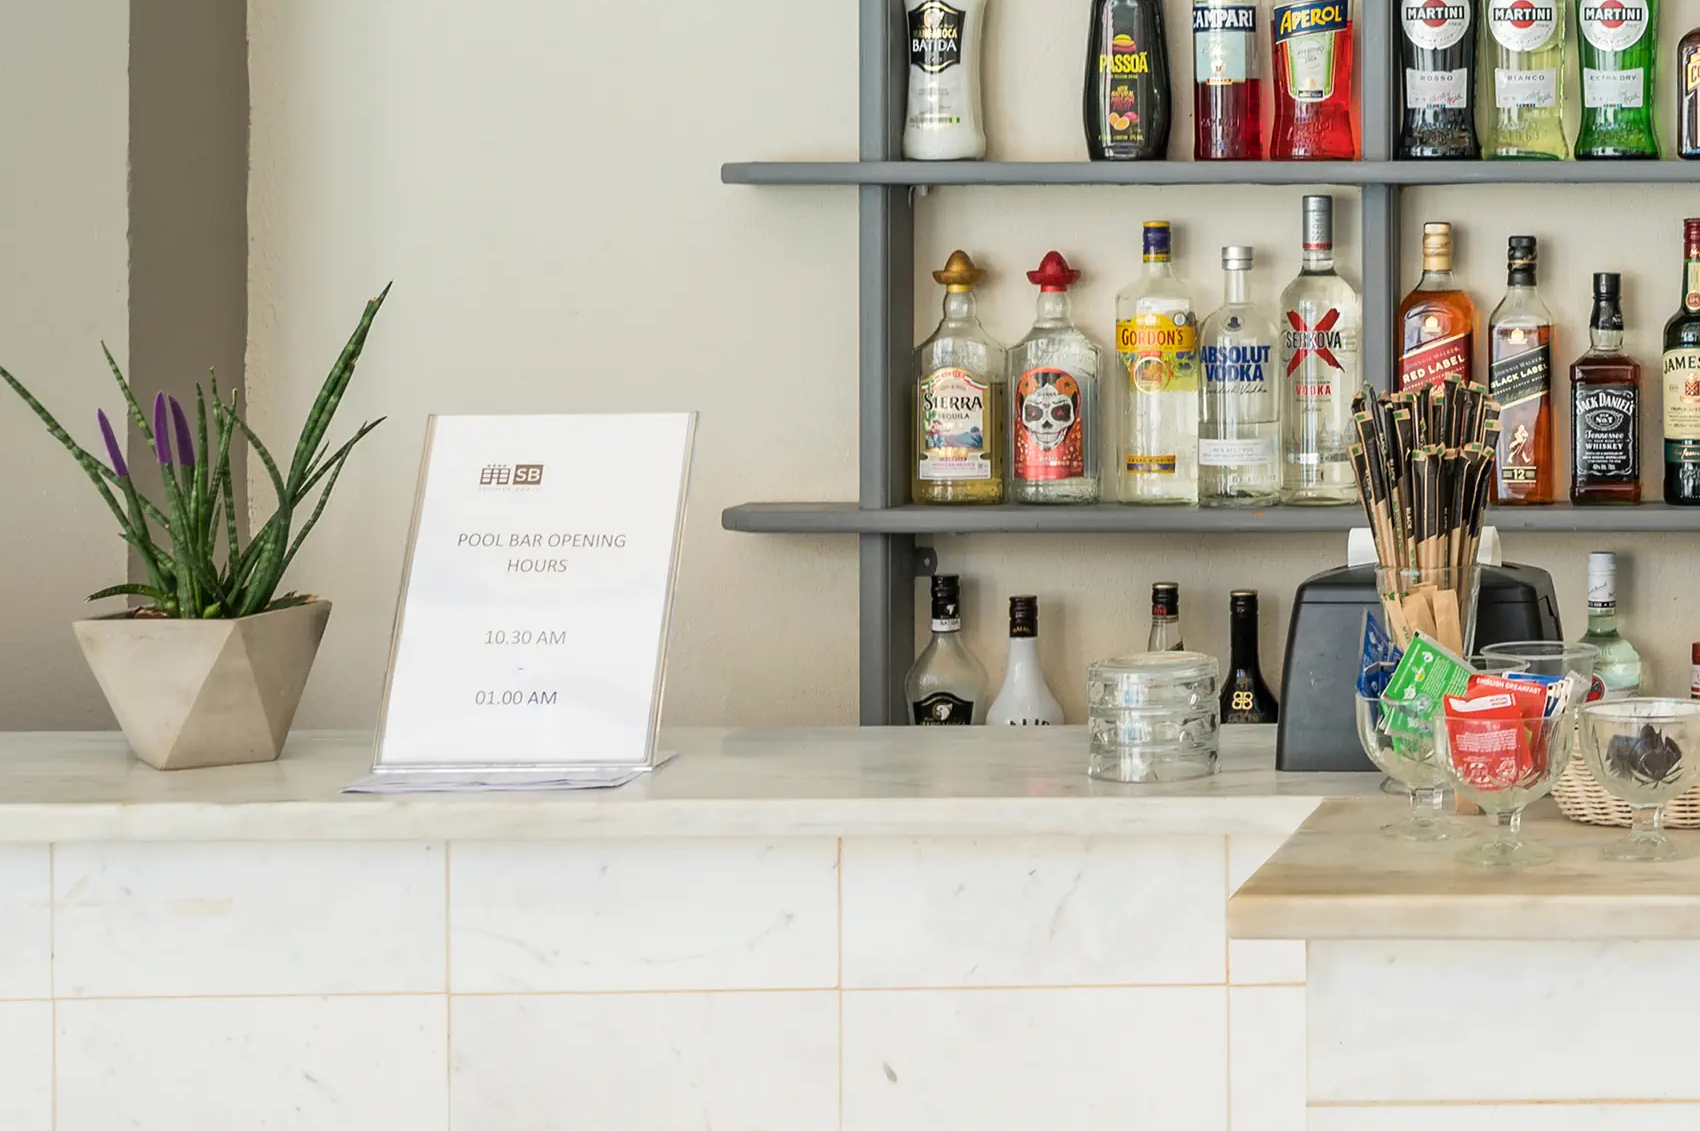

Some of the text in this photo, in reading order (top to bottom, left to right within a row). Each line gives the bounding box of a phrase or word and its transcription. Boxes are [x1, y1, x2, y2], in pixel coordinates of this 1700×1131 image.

[1280, 5, 1343, 35] APEROL
[1406, 6, 1464, 20] MARTINI
[1494, 8, 1551, 21] MARTINI
[1585, 7, 1642, 21] MARTINI
[912, 38, 957, 52] BATIDA
[1121, 328, 1184, 346] GORDON'S
[1286, 330, 1342, 350] SERKOVA
[1200, 345, 1271, 364] ABSOLUT
[1205, 364, 1264, 382] VODKA
[1402, 354, 1465, 384] RED LABEL
[1490, 373, 1519, 389] BLACK
[1520, 363, 1548, 378] LABEL
[1296, 384, 1331, 396] VODKA
[924, 392, 983, 411] SIERRA
[1575, 392, 1635, 415] JACK DANIEL'S
[1584, 430, 1624, 439] Tennessee
[515, 468, 541, 482] SB
[1513, 469, 1525, 480] 12
[457, 533, 627, 549] POOL BAR OPENING
[507, 559, 568, 573] HOURS
[485, 630, 567, 645] 10.30 AM
[1476, 678, 1504, 689] ENGLISH
[475, 690, 558, 706] 01.00 AM
